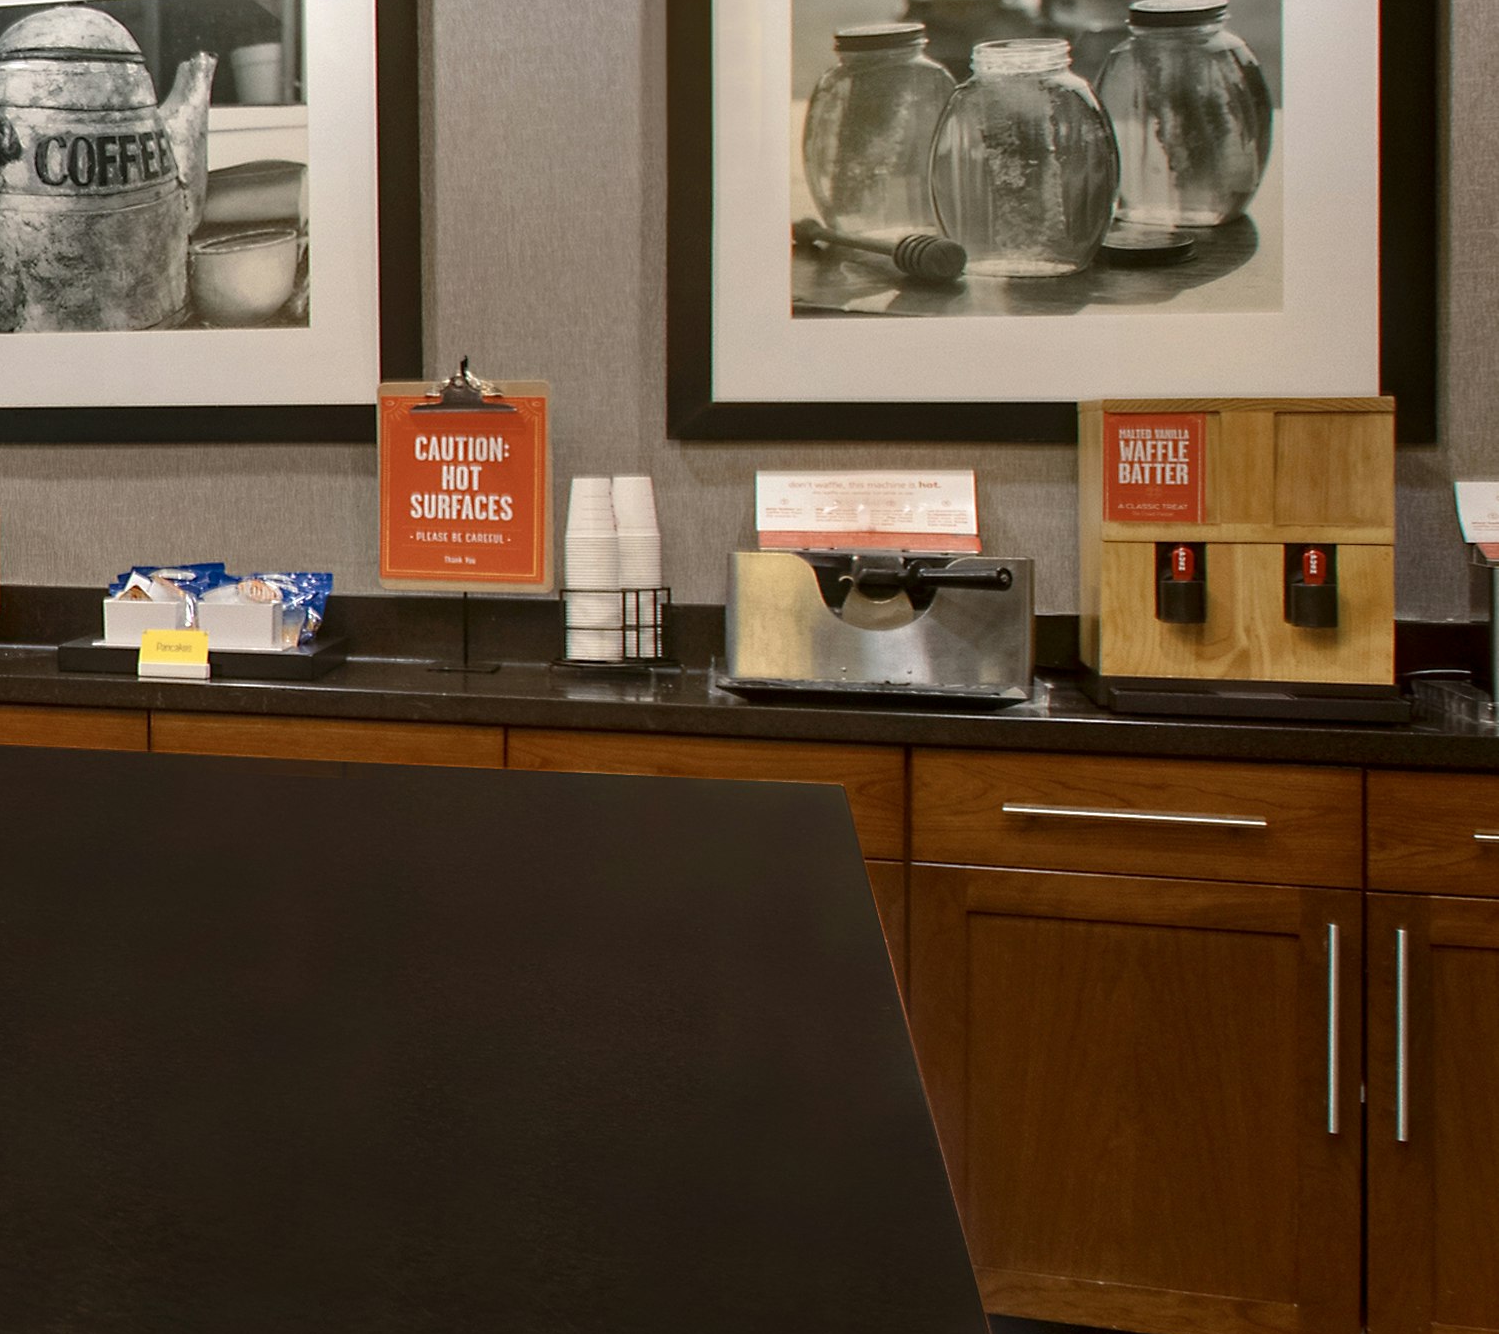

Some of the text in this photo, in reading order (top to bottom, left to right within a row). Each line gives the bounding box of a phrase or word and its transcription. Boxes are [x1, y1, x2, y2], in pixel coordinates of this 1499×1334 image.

[35, 130, 171, 186] COFFEE
[1118, 429, 1189, 439] MALTED VANILLA
[415, 436, 510, 462] CAUTION:
[1119, 440, 1189, 462] WAFFLE
[441, 465, 482, 491] HOT
[918, 481, 941, 489] hot.
[1118, 463, 1189, 485] BATTER
[410, 493, 514, 521] SURFACES
[416, 531, 504, 544] PLEASE BE CAREFUL
[444, 556, 476, 564] Thank You
[156, 642, 192, 653] Pancakes
